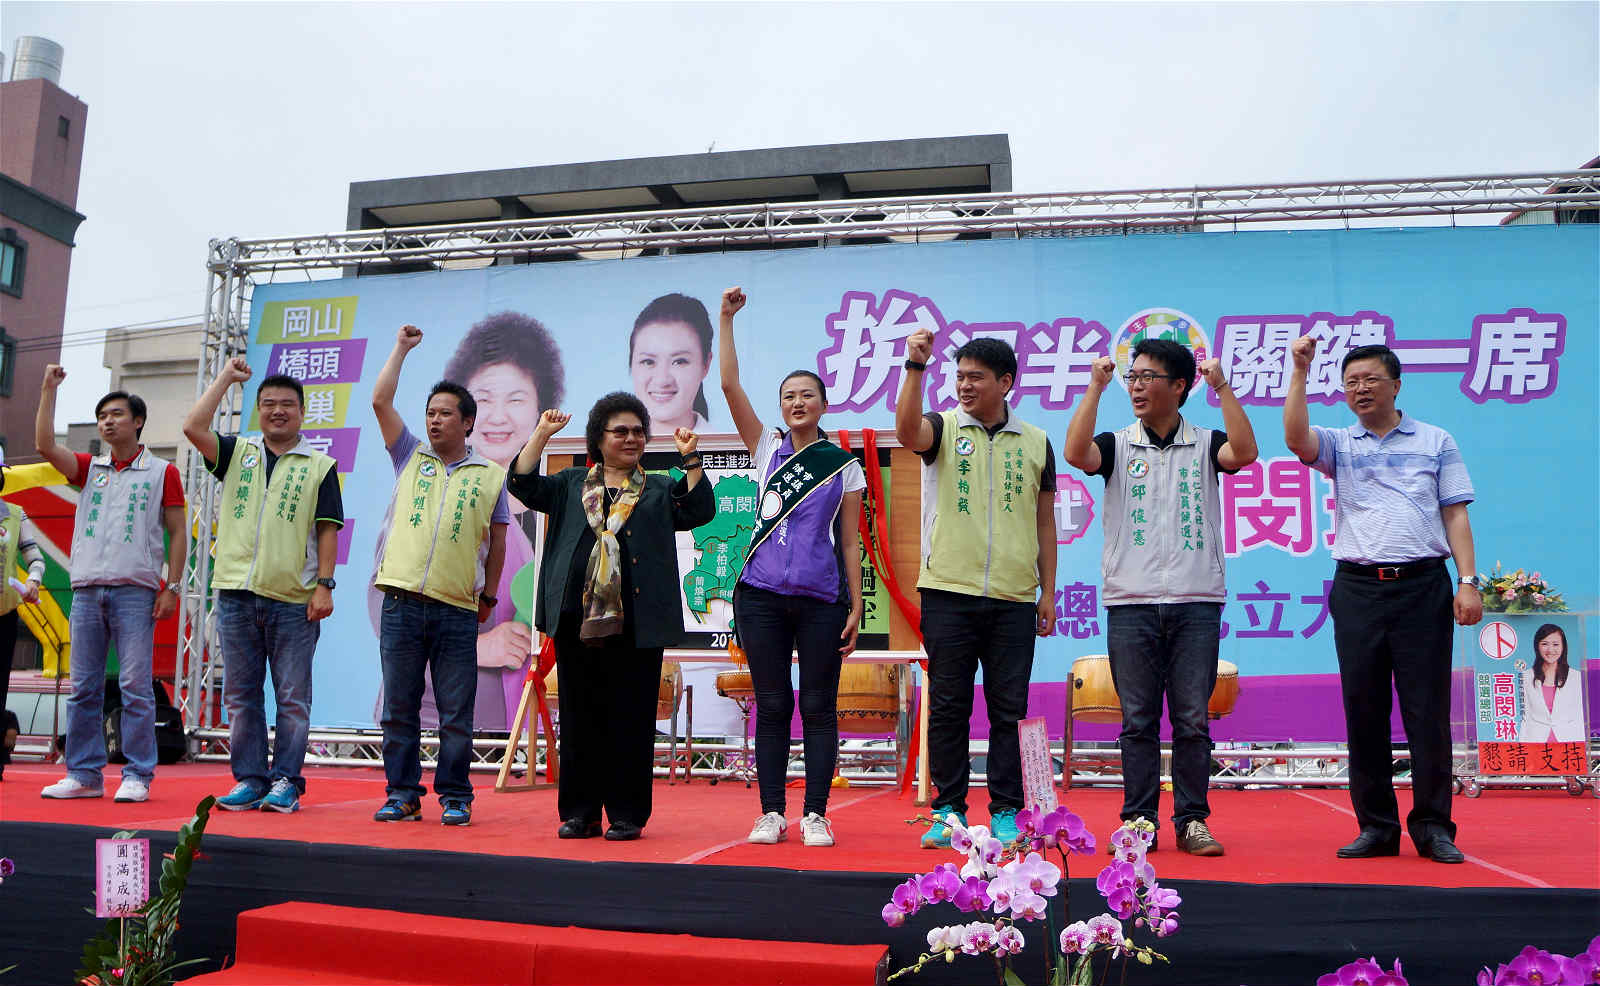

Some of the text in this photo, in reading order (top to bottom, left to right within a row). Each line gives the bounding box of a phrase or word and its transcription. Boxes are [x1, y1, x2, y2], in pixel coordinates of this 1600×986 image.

[281, 303, 343, 339] 岡山
[278, 347, 342, 380] 橋頭
[1217, 317, 1558, 398] 關鍵一席
[702, 454, 757, 469] 民主進步
[719, 495, 757, 513] 高閔
[1494, 672, 1518, 741] 高閔琳
[115, 844, 130, 913] 圓滿成功
